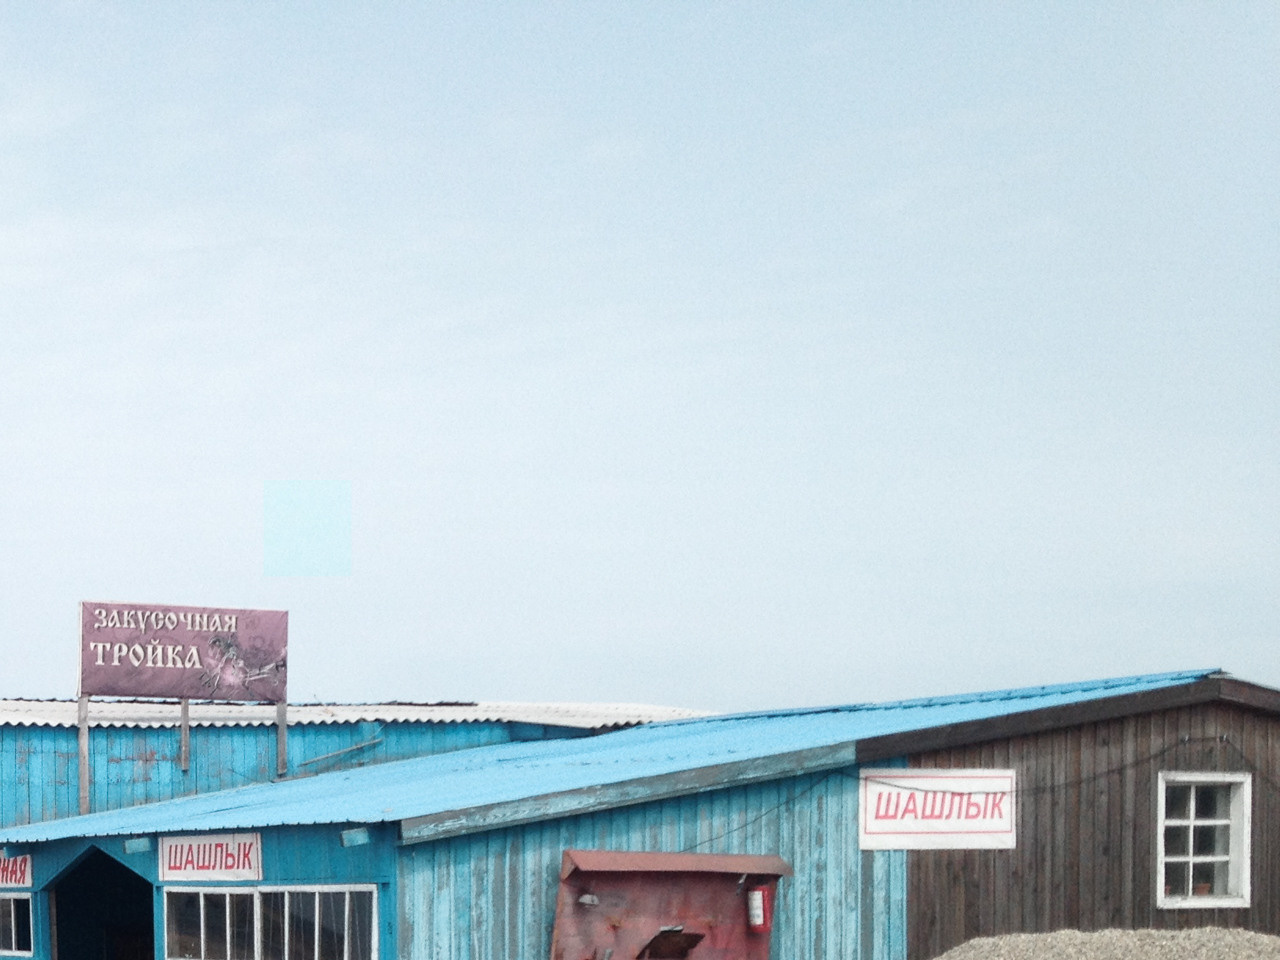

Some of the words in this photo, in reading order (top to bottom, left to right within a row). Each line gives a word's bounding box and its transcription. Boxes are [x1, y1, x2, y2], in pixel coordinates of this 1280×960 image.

[94, 608, 238, 634] ЗАКУСОЧНАЯ
[90, 639, 203, 669] ТРОЙКА
[875, 791, 1007, 820] ШАШЛЫК
[168, 842, 253, 871] ШАШЛЫК
